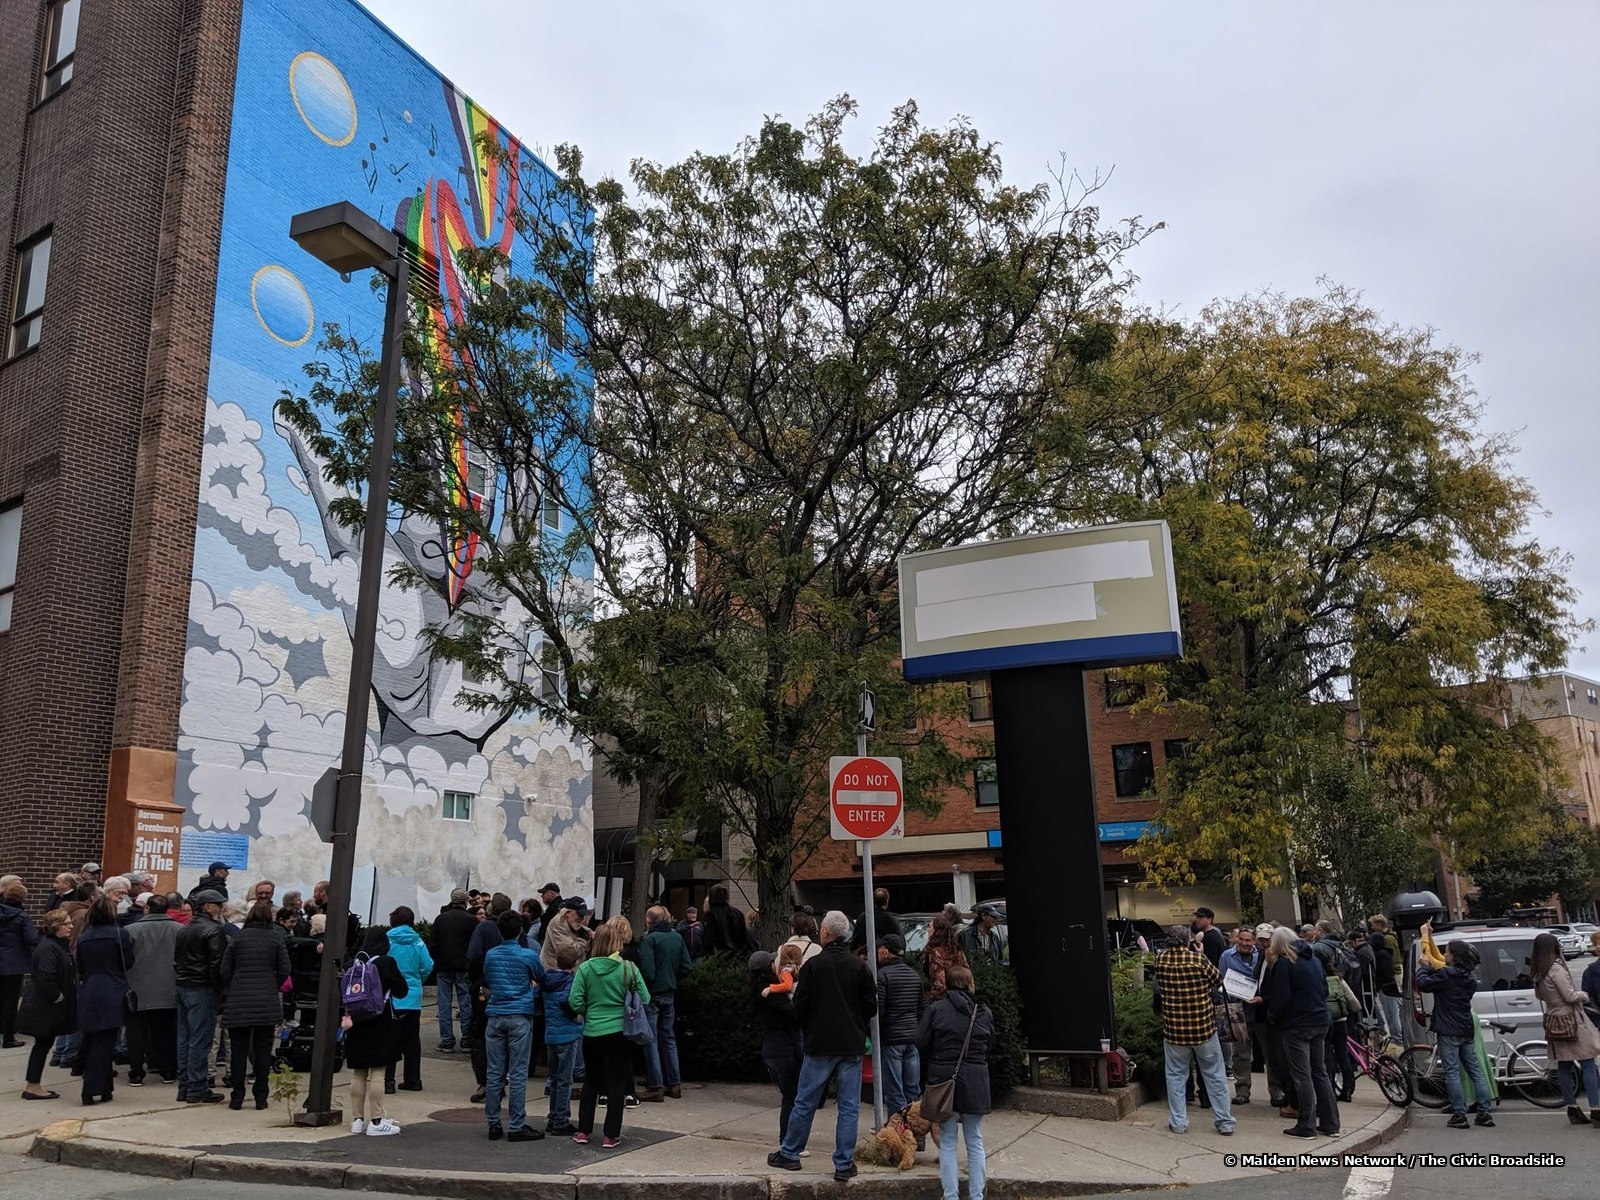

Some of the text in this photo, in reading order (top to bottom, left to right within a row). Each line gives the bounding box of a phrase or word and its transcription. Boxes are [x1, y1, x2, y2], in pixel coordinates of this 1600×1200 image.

[843, 774, 889, 786] DO NOT
[848, 809, 886, 822] ENTER
[137, 822, 180, 834] Greenbaum's
[135, 836, 174, 857] Spirit
[133, 853, 174, 871] In The
